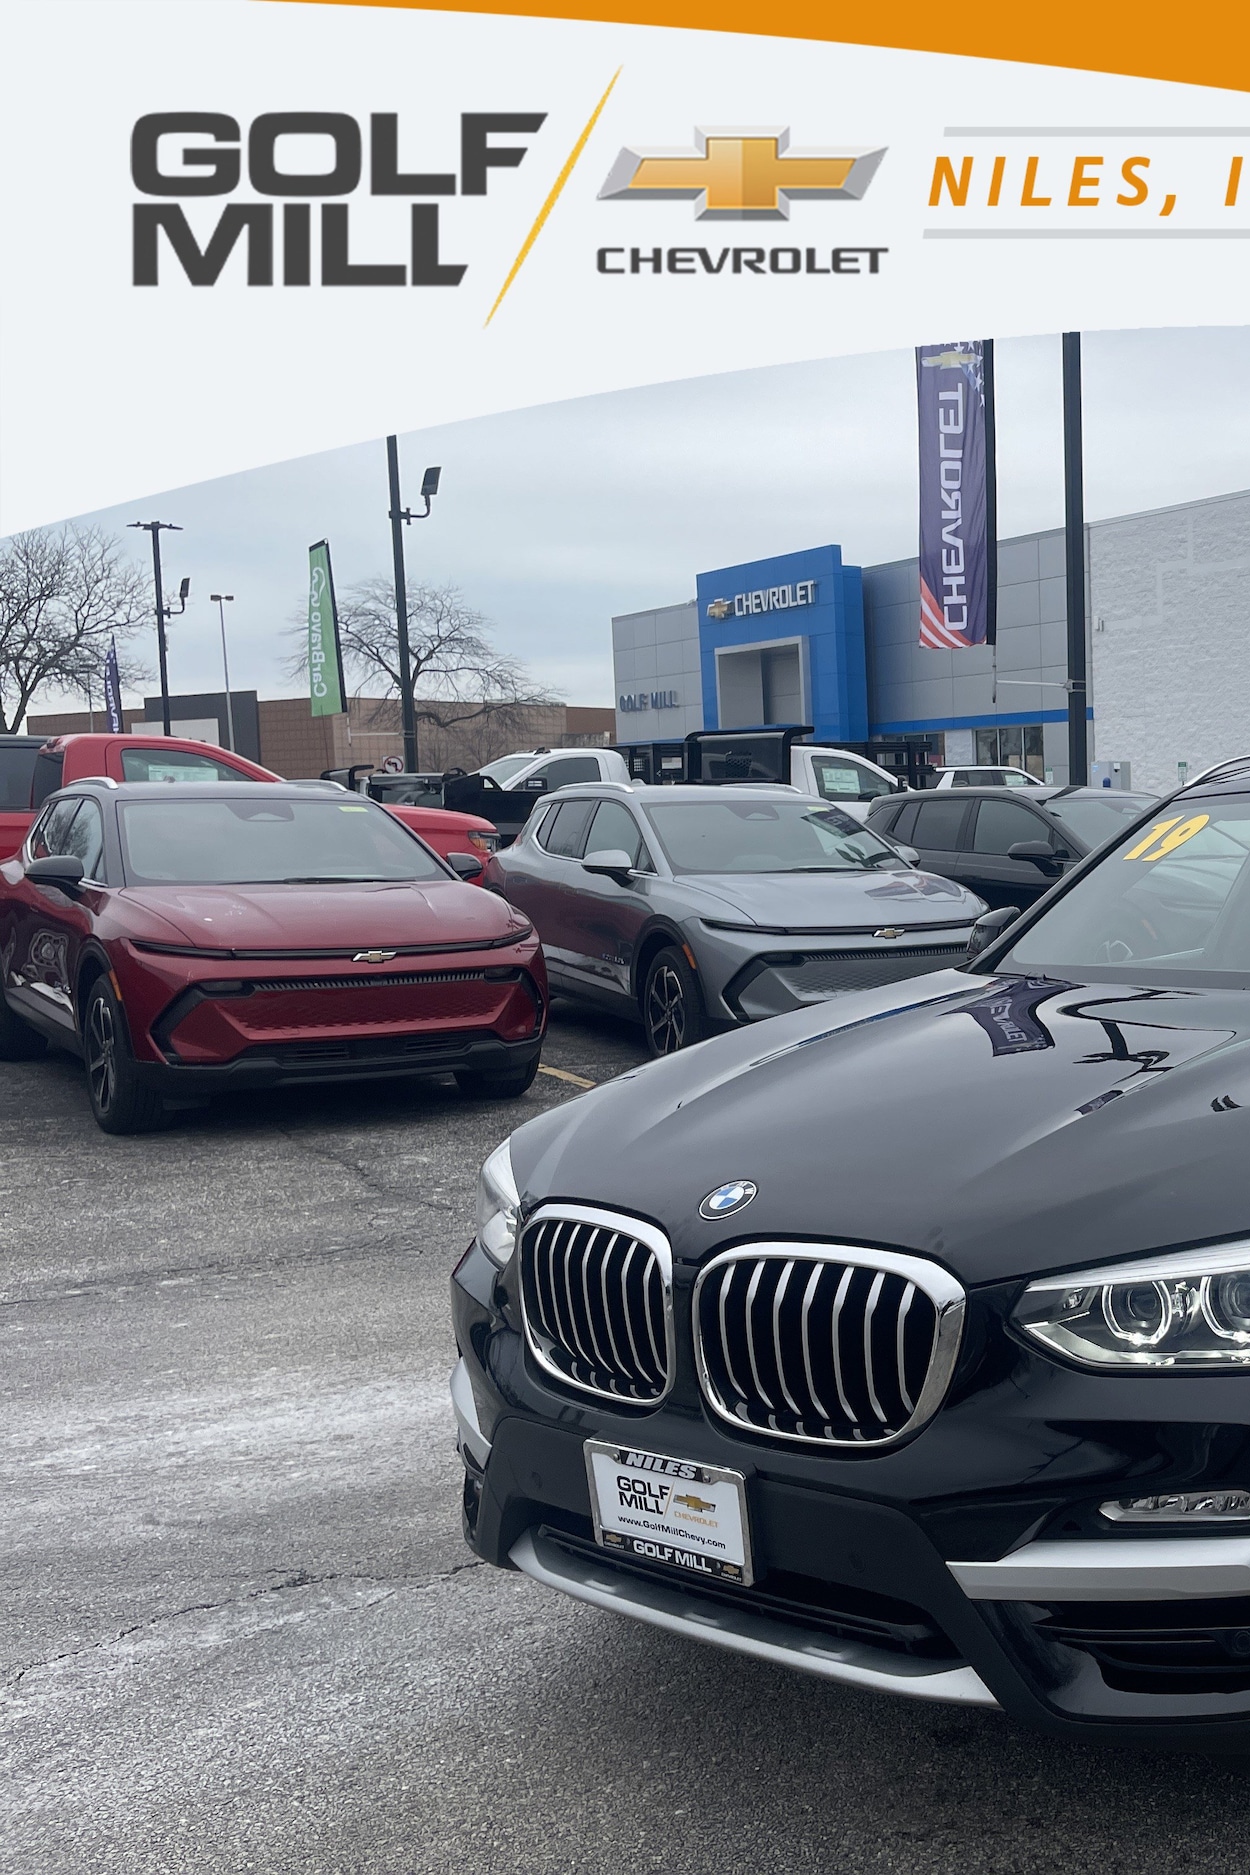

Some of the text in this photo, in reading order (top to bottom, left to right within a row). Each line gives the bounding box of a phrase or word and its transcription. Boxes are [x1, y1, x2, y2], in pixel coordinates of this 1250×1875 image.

[734, 580, 815, 617] CHEVROLET
[620, 690, 678, 712] GOLF MILL
[1122, 814, 1210, 862] 19
[625, 1453, 697, 1480] NILES
[616, 1475, 671, 1501] GOLF
[618, 1491, 664, 1516] MILL
[617, 1515, 727, 1550] www.GolfMillChevy.com
[674, 1511, 719, 1529] CHEVROLET
[633, 1539, 713, 1573] GOLF MILL
